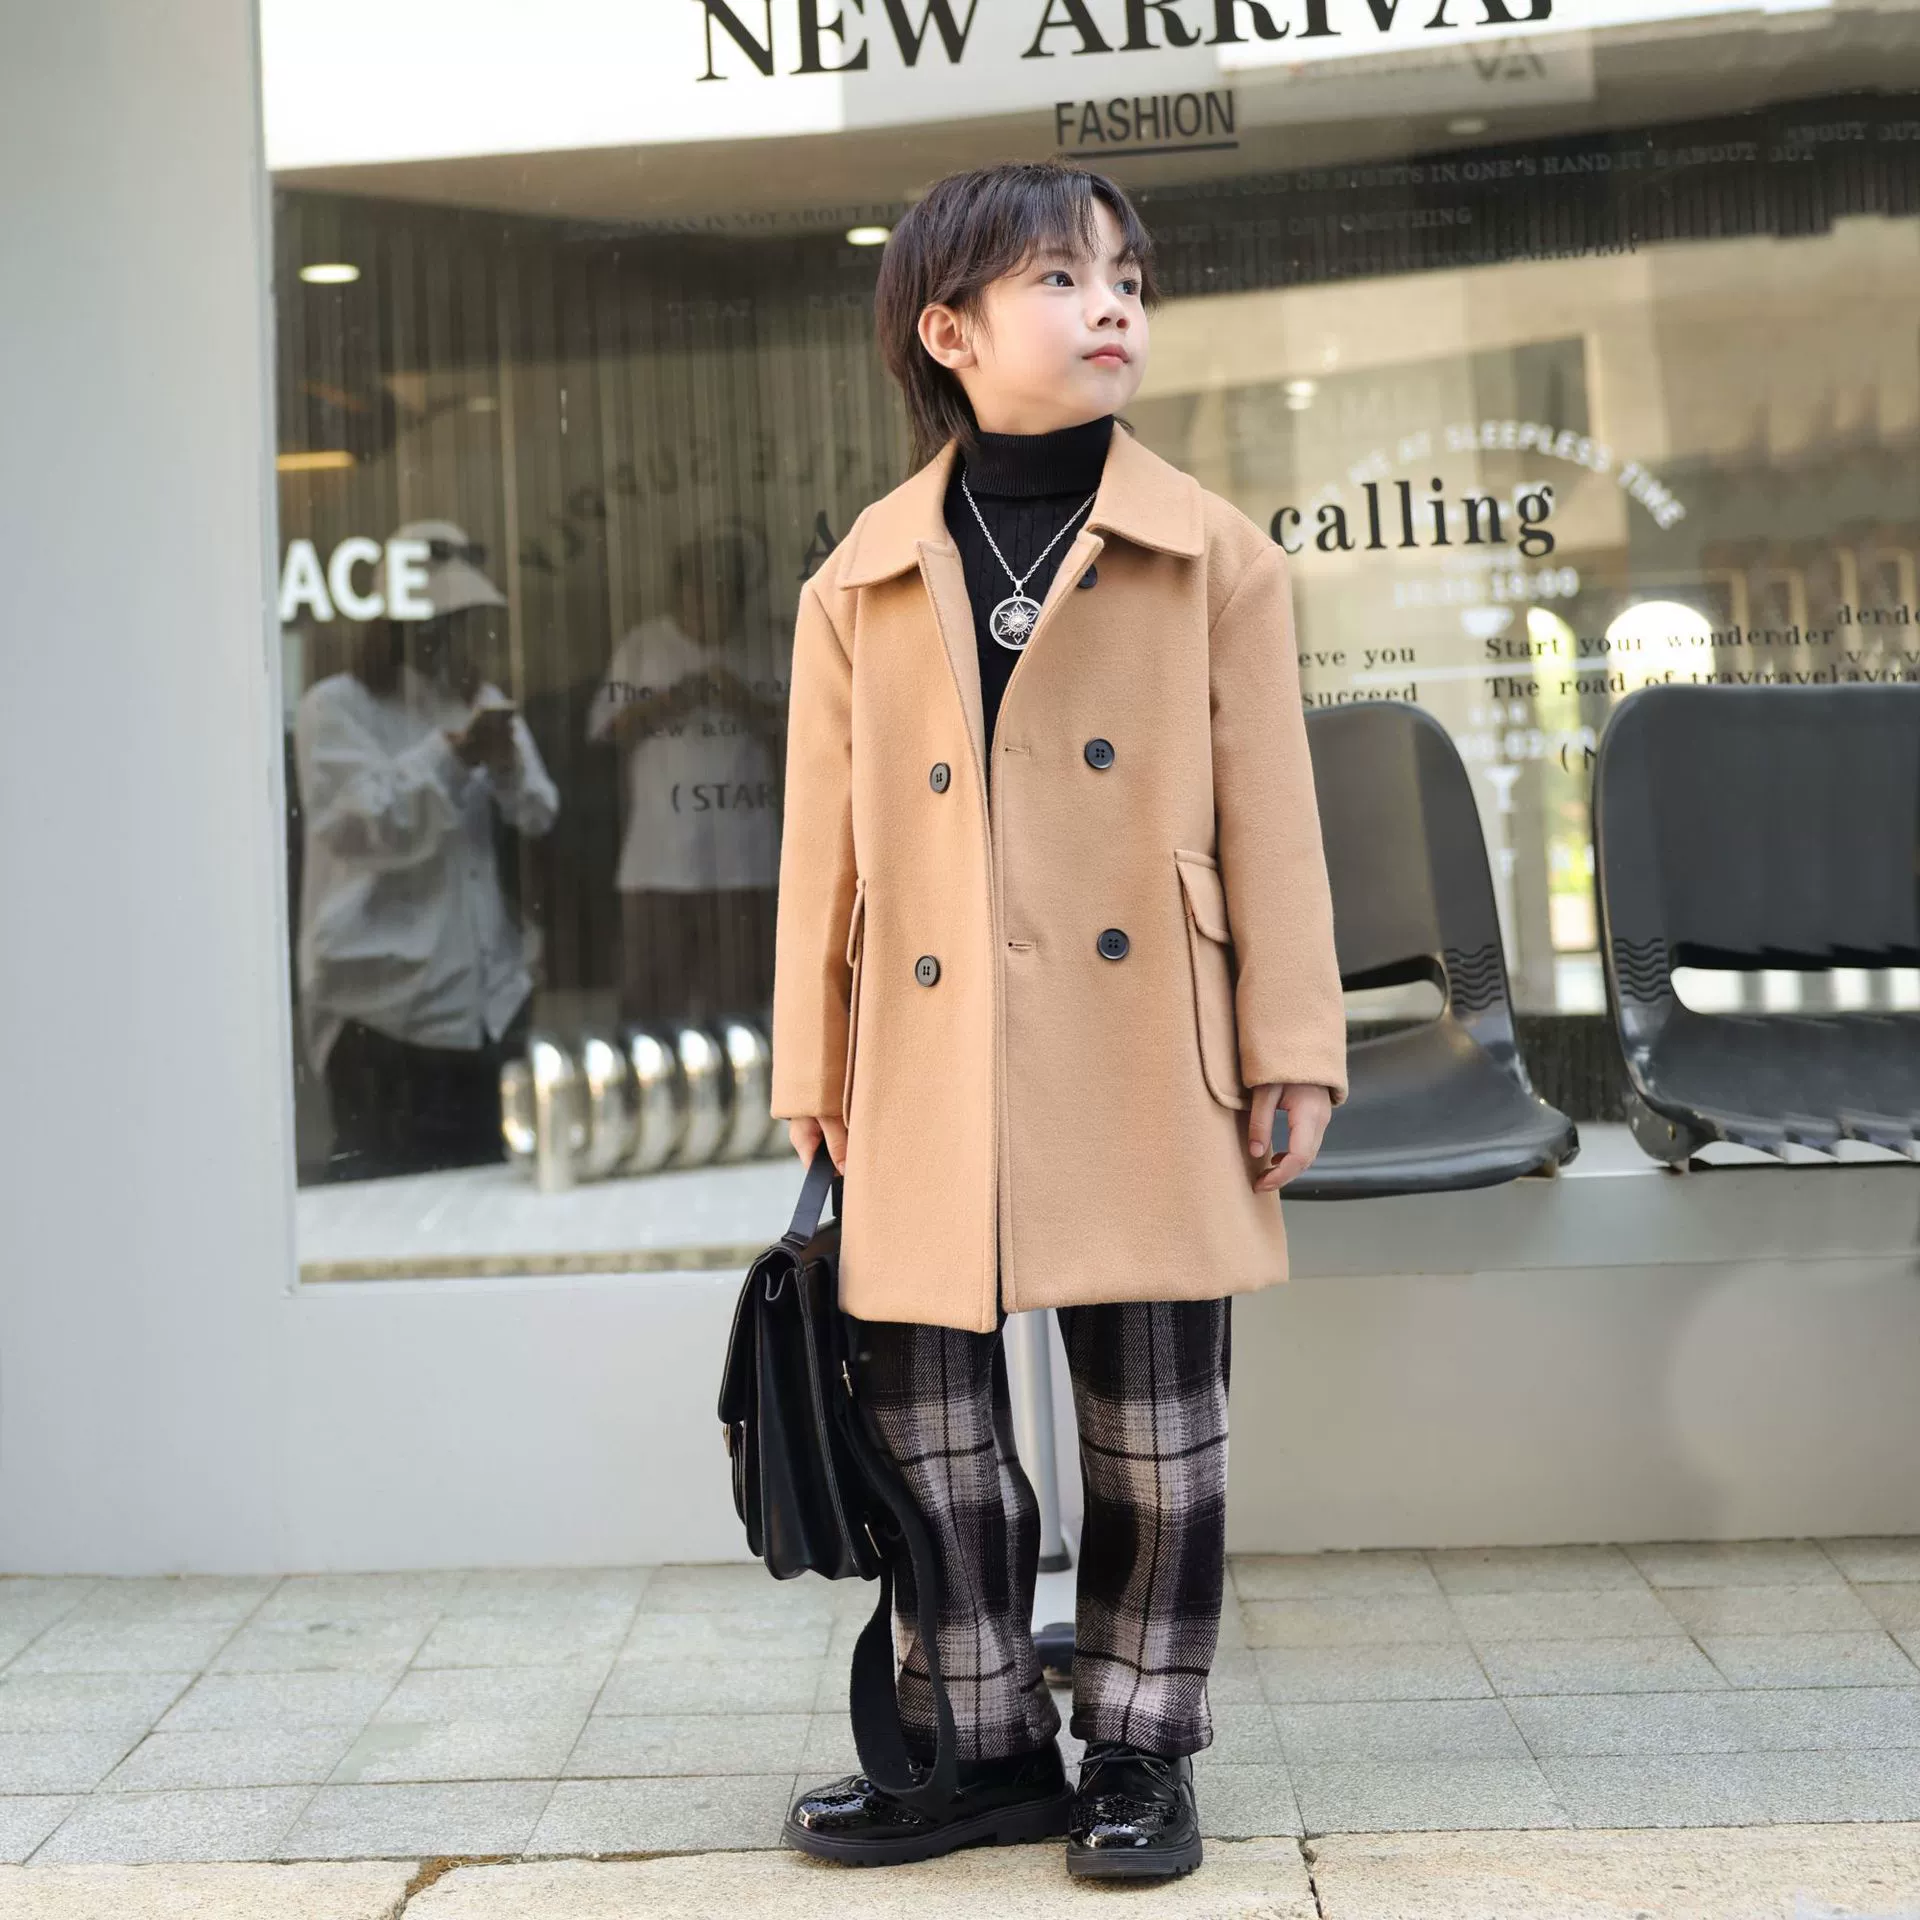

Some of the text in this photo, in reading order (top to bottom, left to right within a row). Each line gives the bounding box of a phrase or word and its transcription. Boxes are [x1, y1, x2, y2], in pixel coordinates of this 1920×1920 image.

[696, 0, 977, 81] NEW
[1055, 90, 1237, 146] FASHION
[1431, 163, 1461, 184] IN
[1270, 479, 1555, 557] calling
[281, 536, 436, 622] ACE
[1364, 644, 1416, 670] you
[1485, 637, 1560, 660] Start
[1580, 637, 1644, 663] your
[1302, 683, 1418, 706] succeed
[1485, 676, 1540, 700] The
[1560, 672, 1626, 697] road
